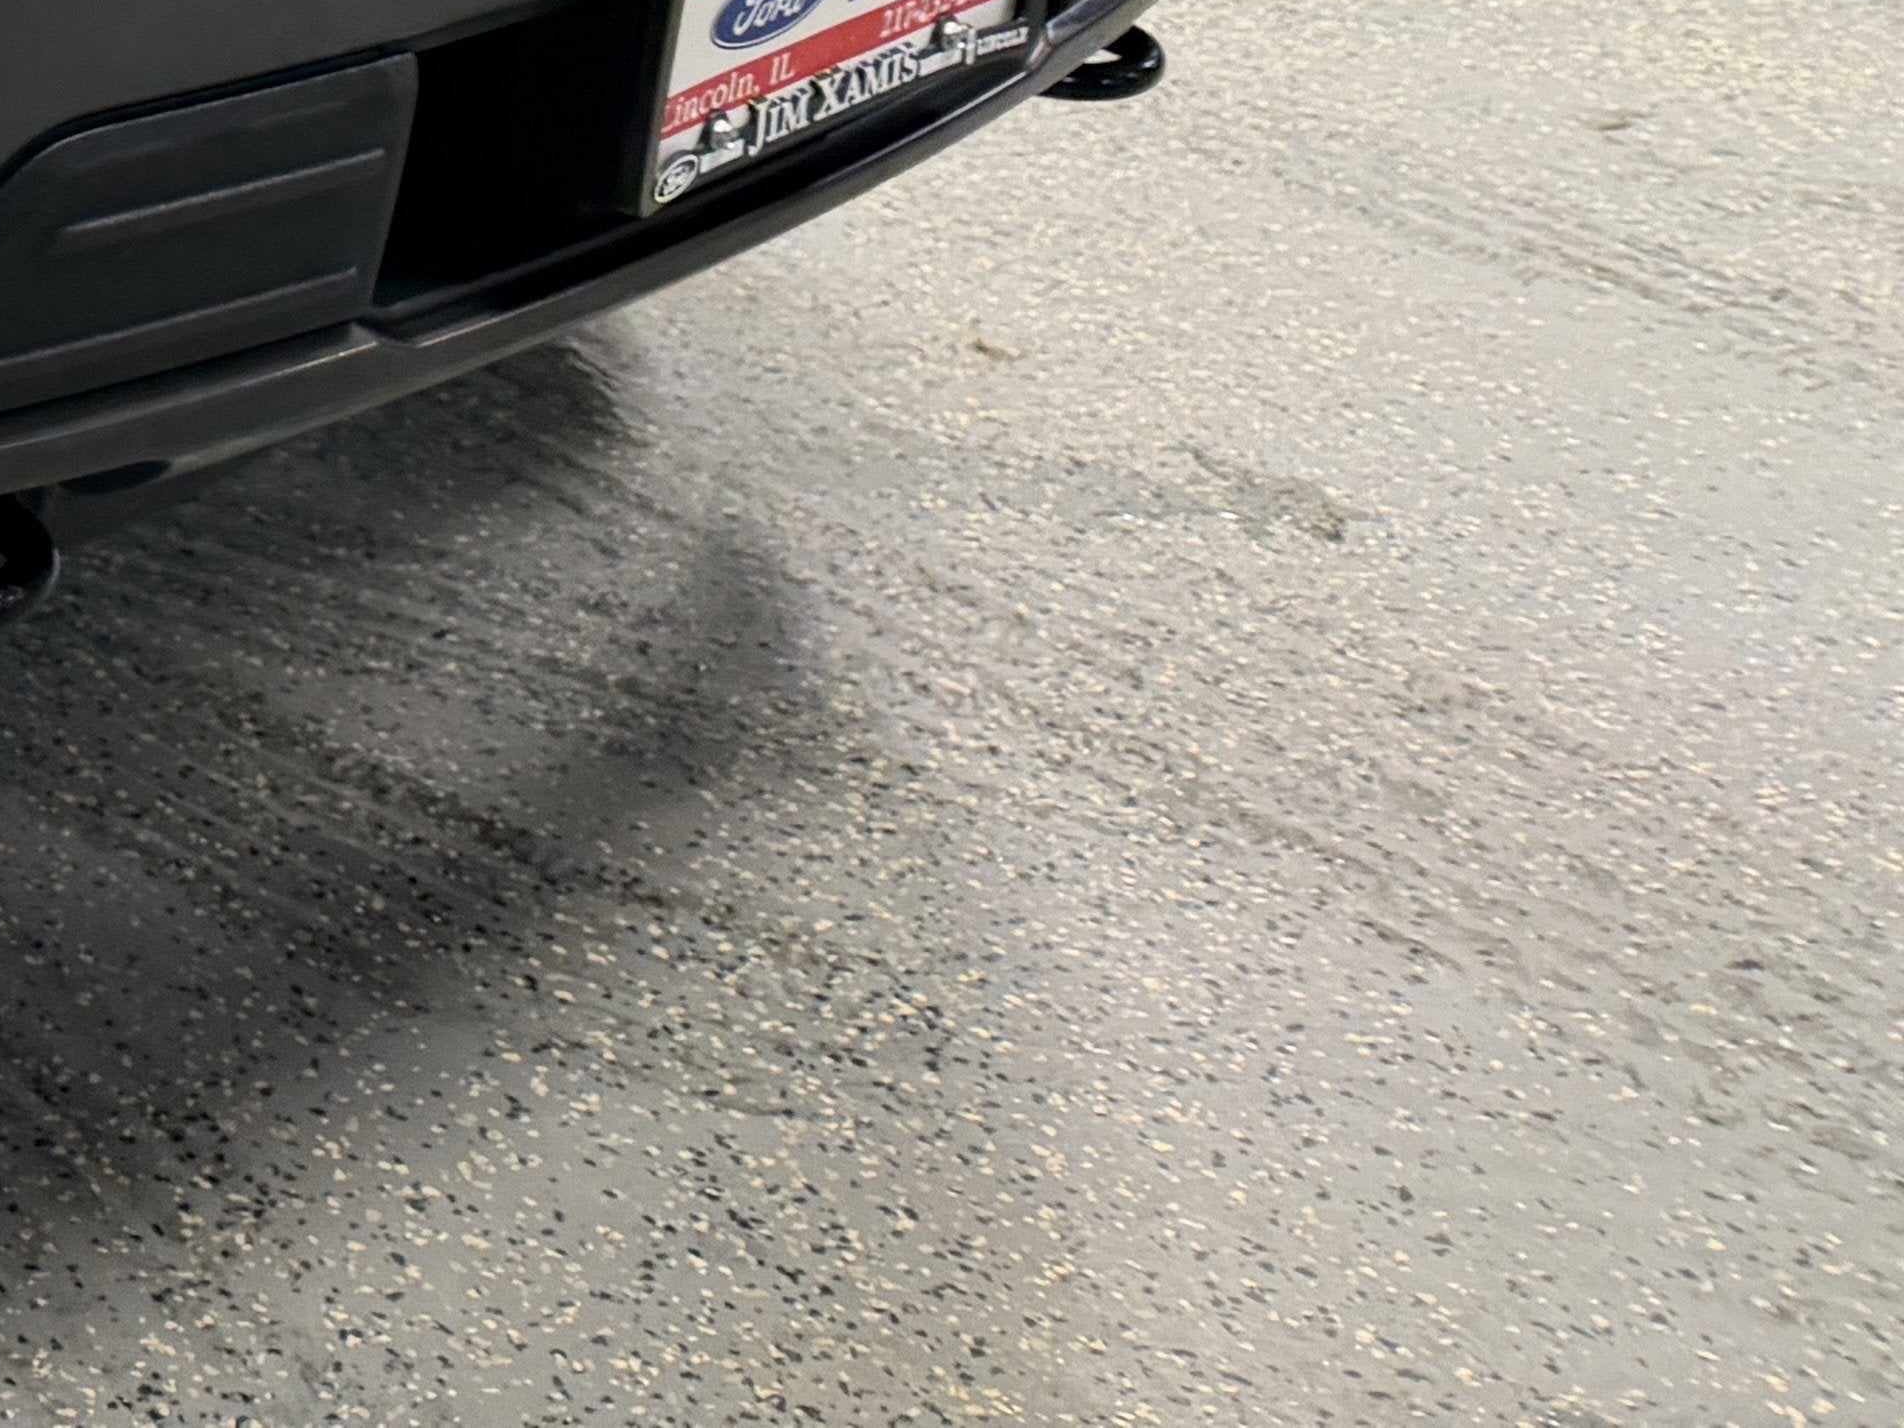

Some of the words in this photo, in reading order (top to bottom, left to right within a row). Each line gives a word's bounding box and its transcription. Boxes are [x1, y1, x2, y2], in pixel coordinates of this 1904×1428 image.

[770, 52, 796, 85] IL
[749, 88, 810, 157] JIM
[814, 53, 922, 122] XAMIS
